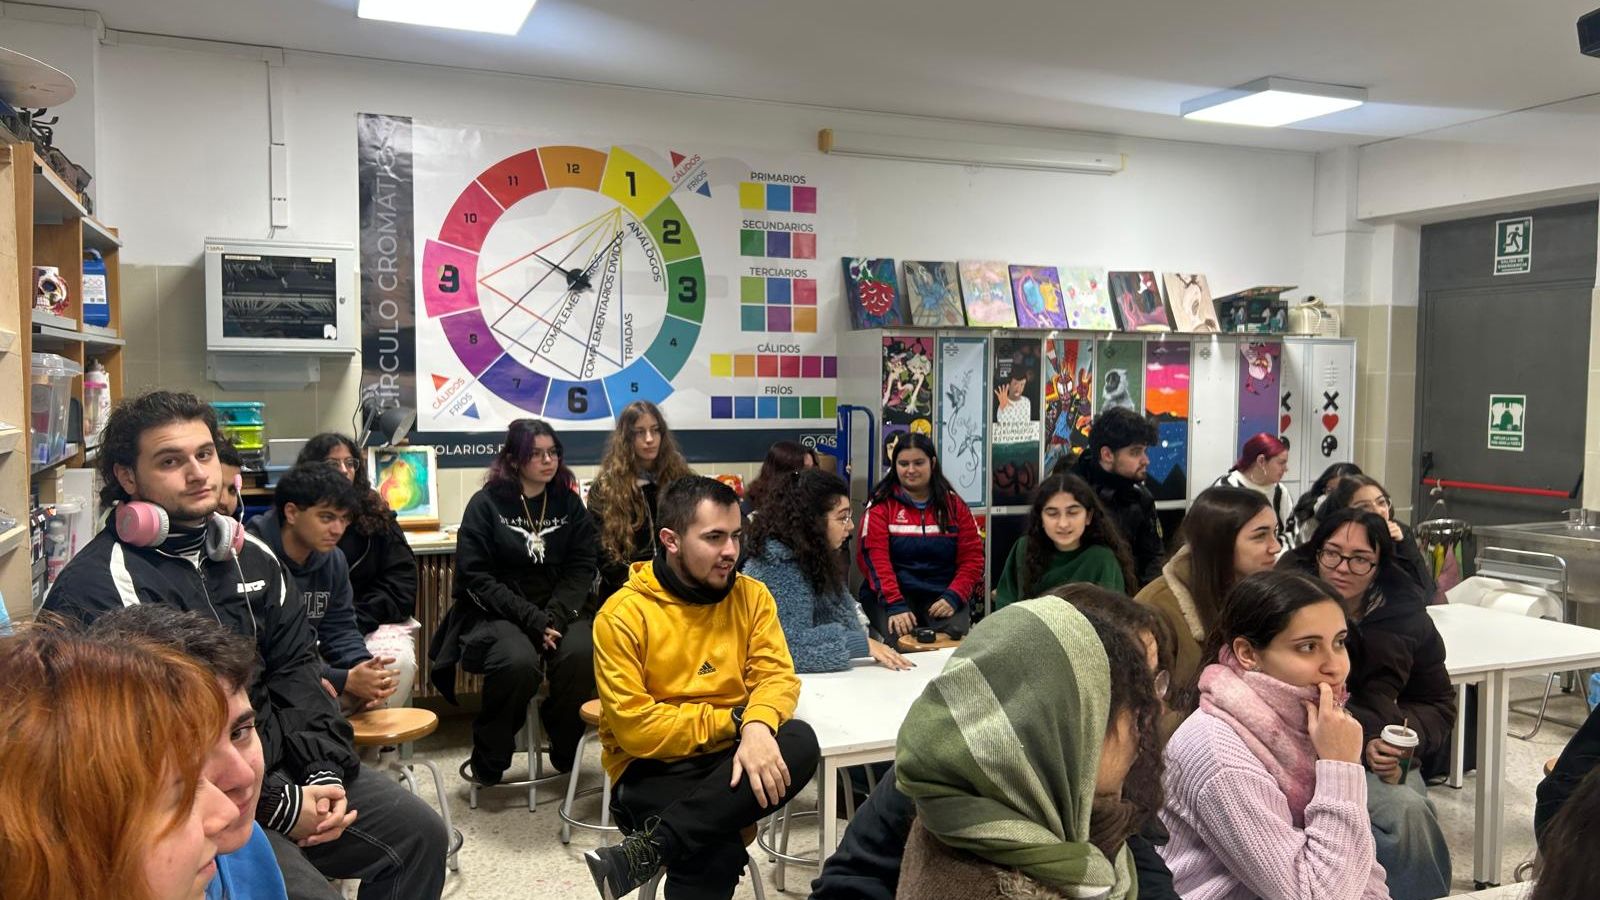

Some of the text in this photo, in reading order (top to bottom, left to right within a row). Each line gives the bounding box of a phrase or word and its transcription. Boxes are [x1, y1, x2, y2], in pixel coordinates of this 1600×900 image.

[567, 163, 580, 174] 12
[508, 176, 519, 186] 11
[751, 171, 807, 184] PRIMARIOS
[625, 171, 637, 197] 1
[464, 213, 478, 223] 10
[663, 219, 681, 244] 2
[742, 220, 814, 232] SECUNDARIOS
[749, 267, 808, 278] TERCIARIOS
[438, 265, 459, 293] 9
[678, 276, 698, 303] 3
[584, 274, 614, 379] COMPLEMENTARIOS
[469, 334, 478, 344] 8
[670, 338, 678, 347] 4
[757, 343, 801, 353] CÁLIDOS
[512, 379, 521, 389] 7
[631, 382, 639, 393] 5
[764, 384, 793, 395] FRÍOS
[567, 387, 588, 414] 6
